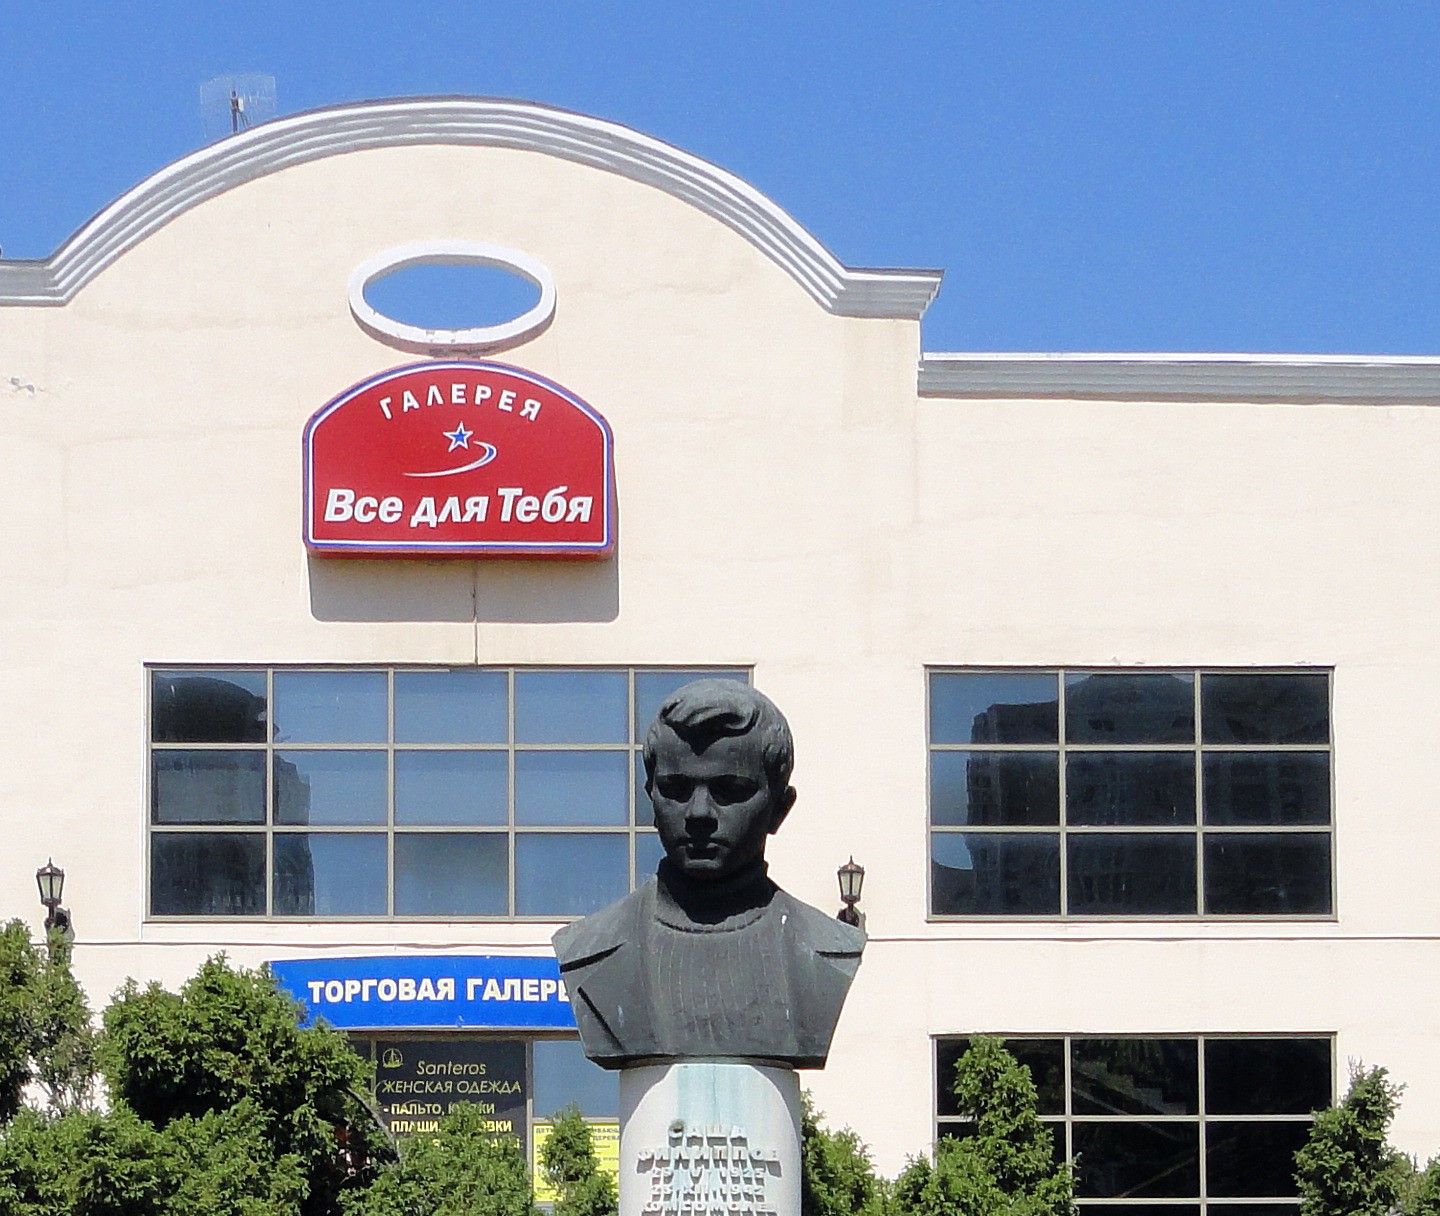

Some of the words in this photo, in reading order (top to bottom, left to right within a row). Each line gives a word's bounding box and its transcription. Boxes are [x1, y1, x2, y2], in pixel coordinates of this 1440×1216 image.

[379, 383, 542, 421] ГАЛЕРЕЯ
[323, 488, 403, 522] Все
[410, 496, 489, 527] для
[497, 485, 593, 522] Тебя
[308, 978, 455, 1003] ТОРГОВАЯ
[466, 978, 570, 1002] ГАЛЕРЕ
[416, 1061, 487, 1075] Santeros
[381, 1080, 453, 1094] ЖЕНСКАЯ
[456, 1080, 522, 1095] ОДЕЖДА
